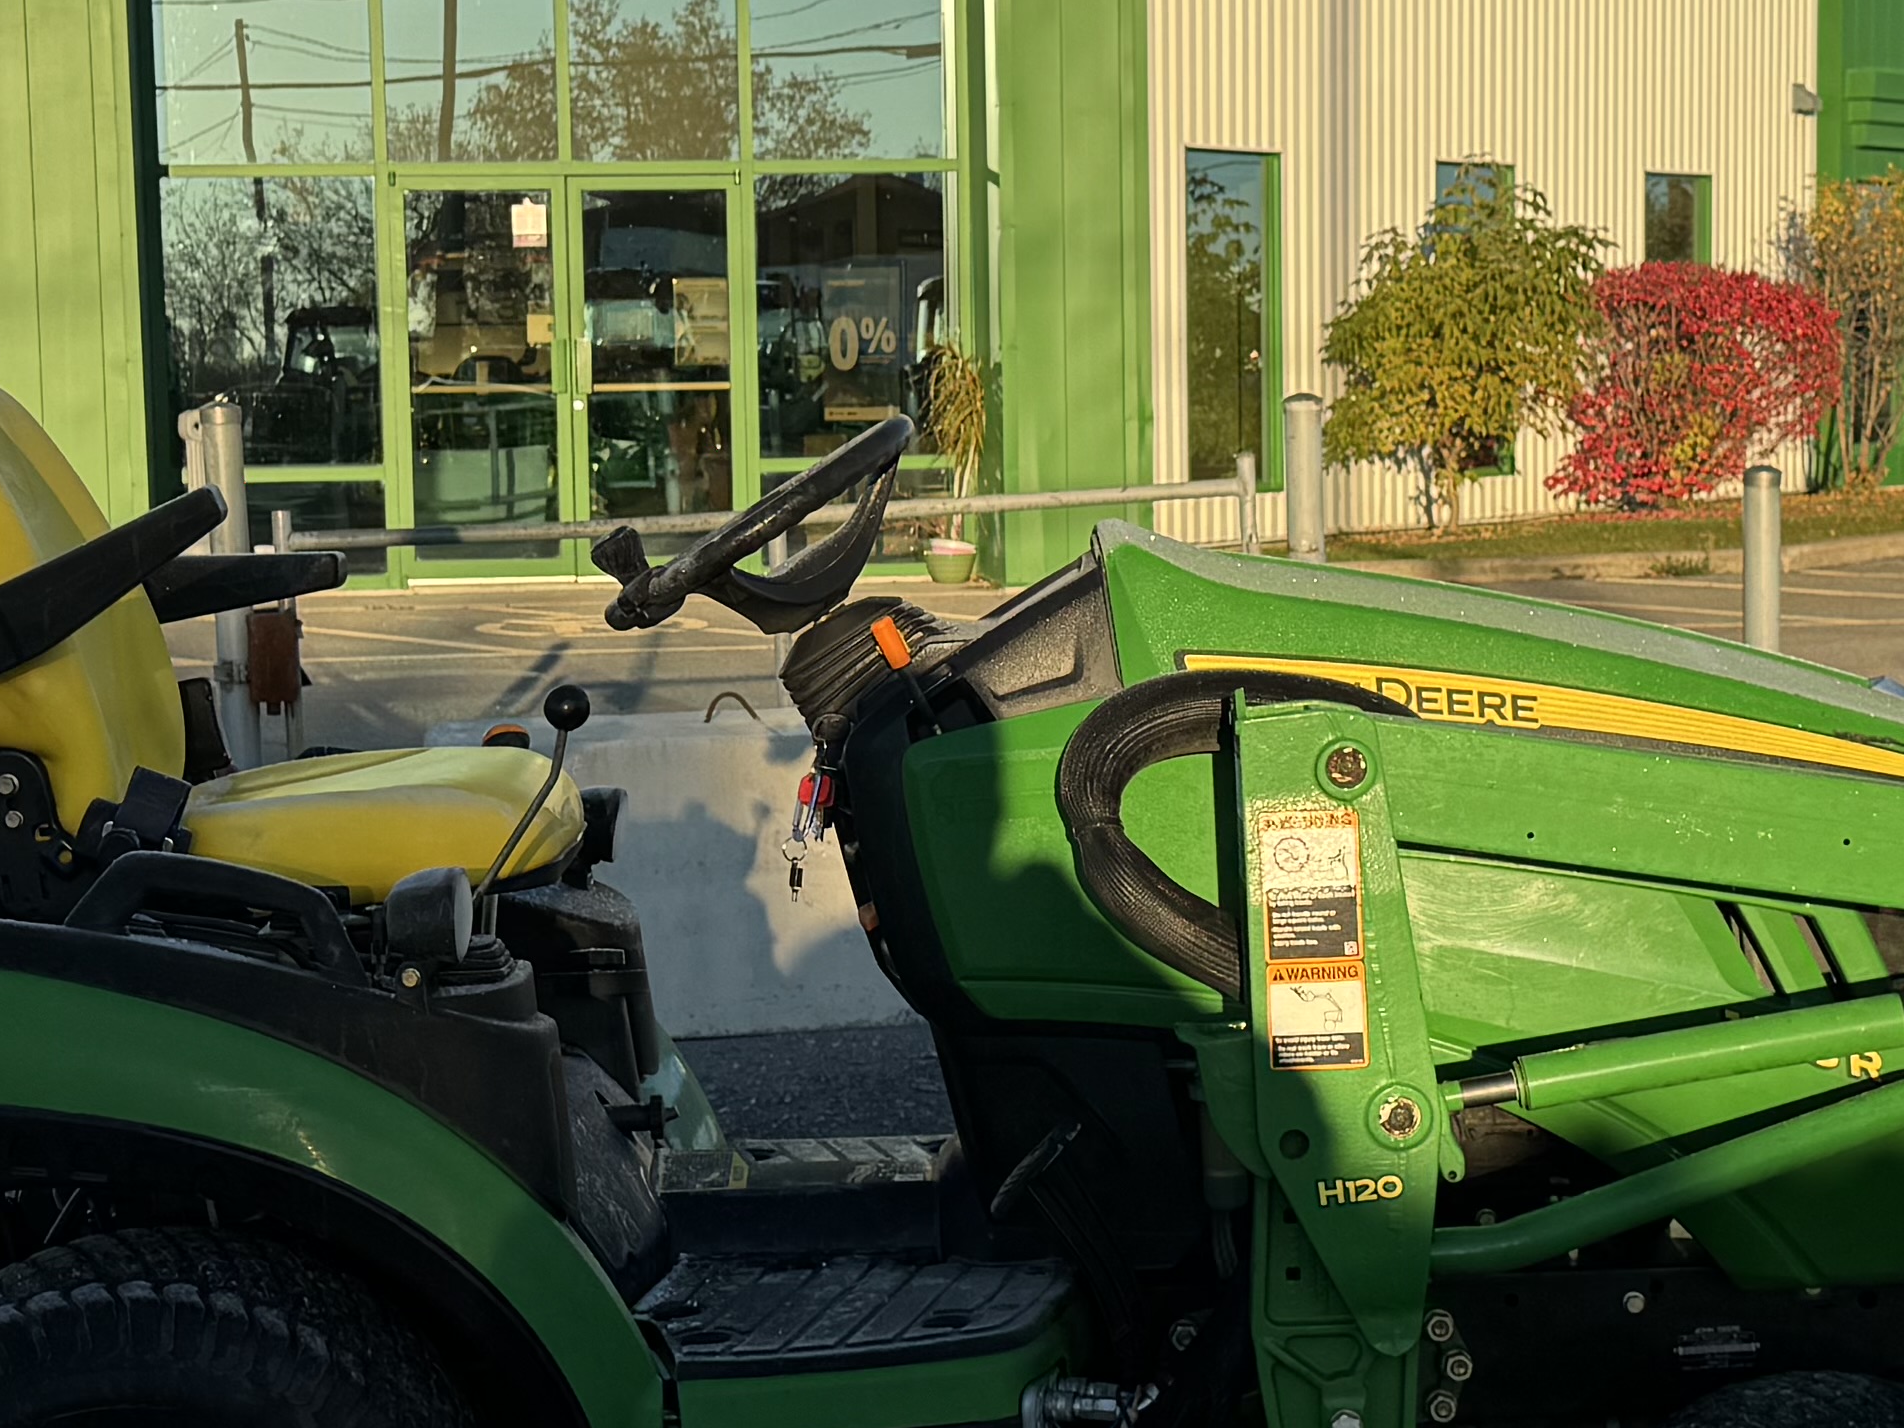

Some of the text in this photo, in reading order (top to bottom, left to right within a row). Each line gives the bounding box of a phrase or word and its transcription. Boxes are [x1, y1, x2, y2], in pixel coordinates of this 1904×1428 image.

[828, 316, 897, 371] 0%
[1375, 676, 1540, 724] DEERE
[1285, 964, 1359, 981] WARNING
[1317, 1174, 1404, 1207] H120
